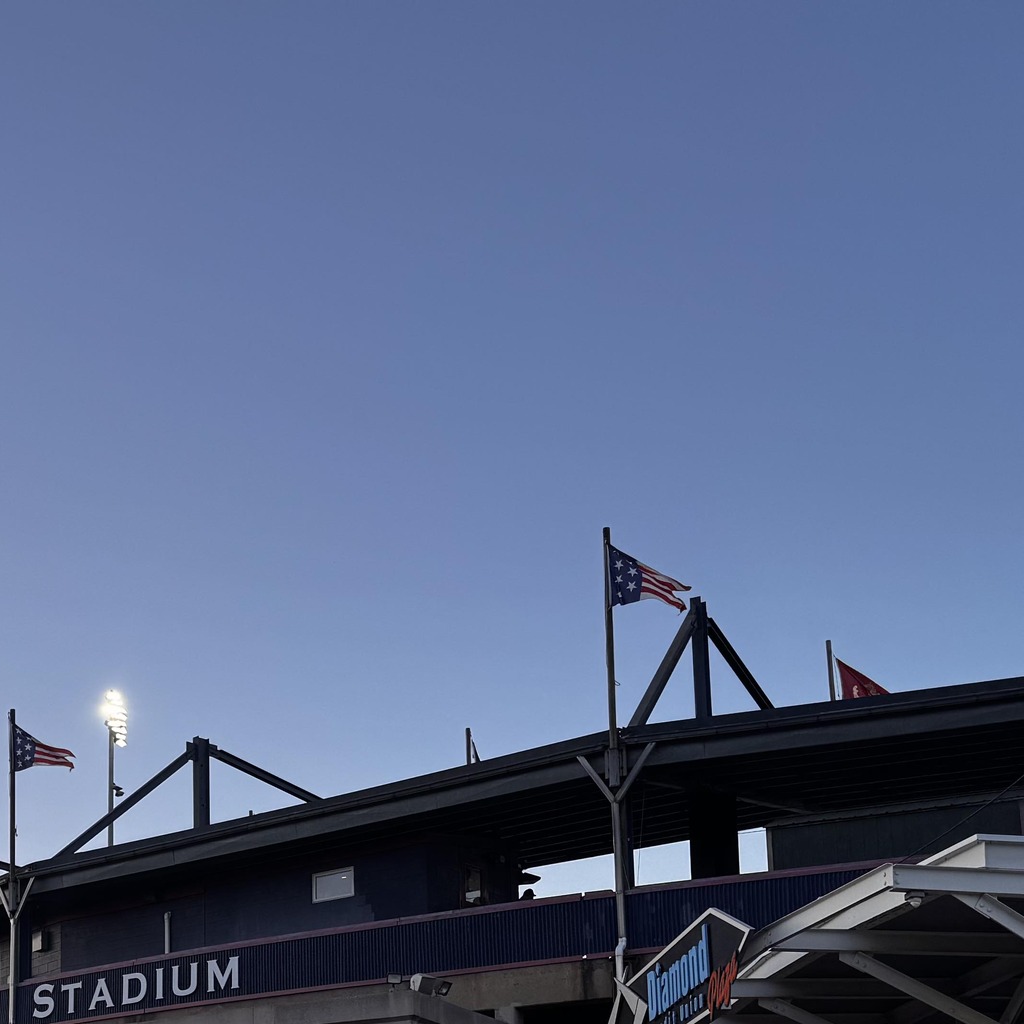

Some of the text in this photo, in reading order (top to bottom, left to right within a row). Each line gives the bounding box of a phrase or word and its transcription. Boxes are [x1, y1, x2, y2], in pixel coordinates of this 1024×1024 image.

[32, 956, 241, 1019] STADIUM
[646, 923, 710, 1023] Diamond
[707, 949, 739, 1022] Plaza
